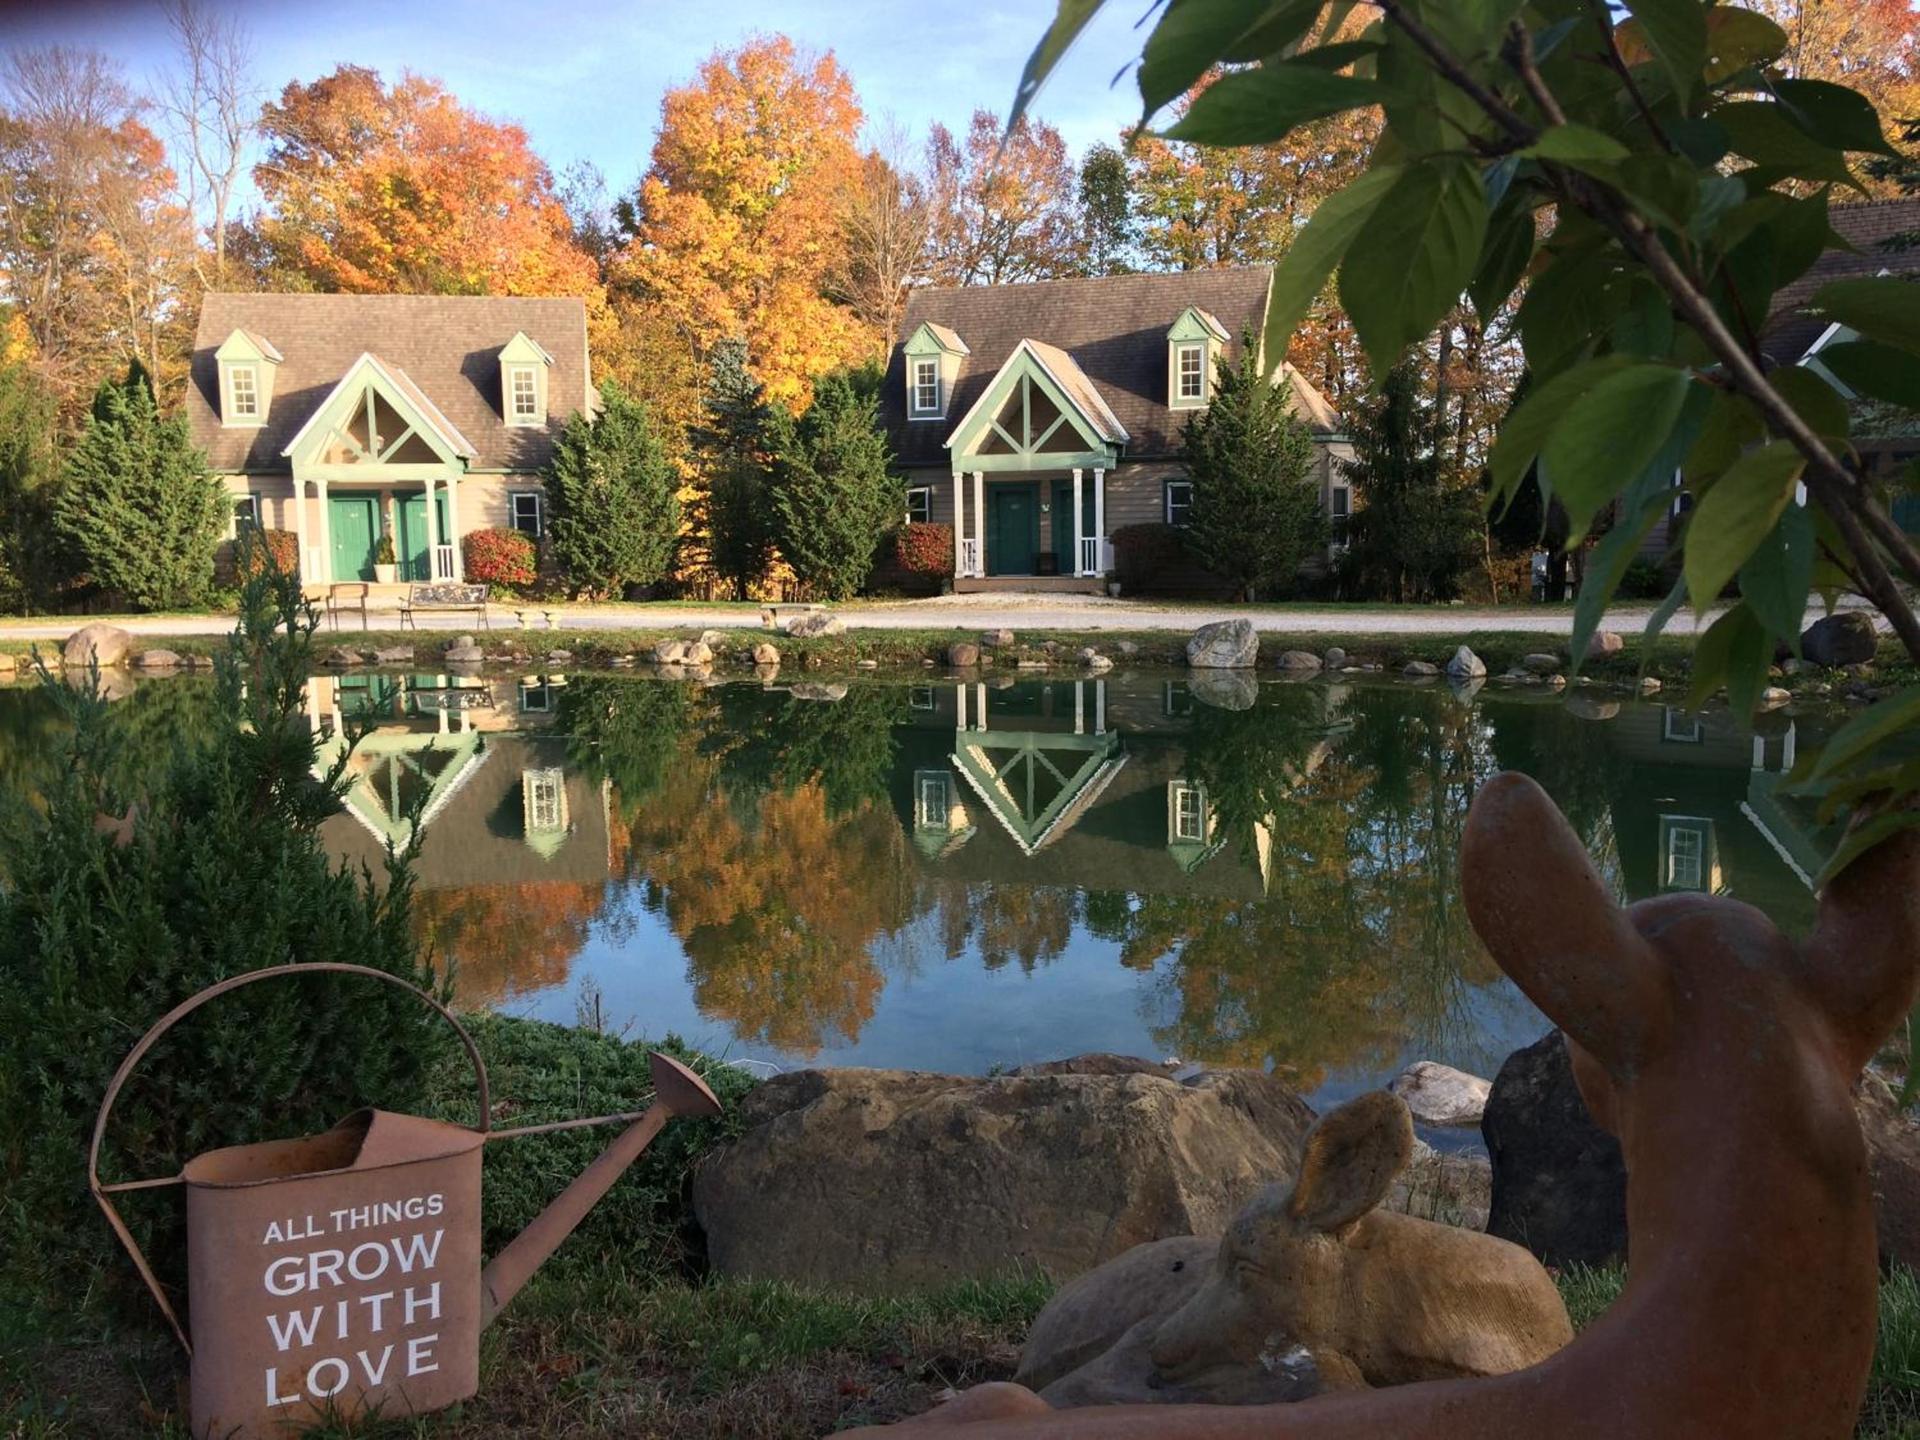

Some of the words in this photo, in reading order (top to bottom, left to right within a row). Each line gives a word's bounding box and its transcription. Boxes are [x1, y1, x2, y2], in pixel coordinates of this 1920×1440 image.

[262, 1215, 325, 1246] ALL
[330, 1193, 444, 1233] THINGS
[263, 1229, 445, 1297] GROW
[265, 1281, 441, 1352] WITH
[265, 1333, 440, 1407] LOVE
